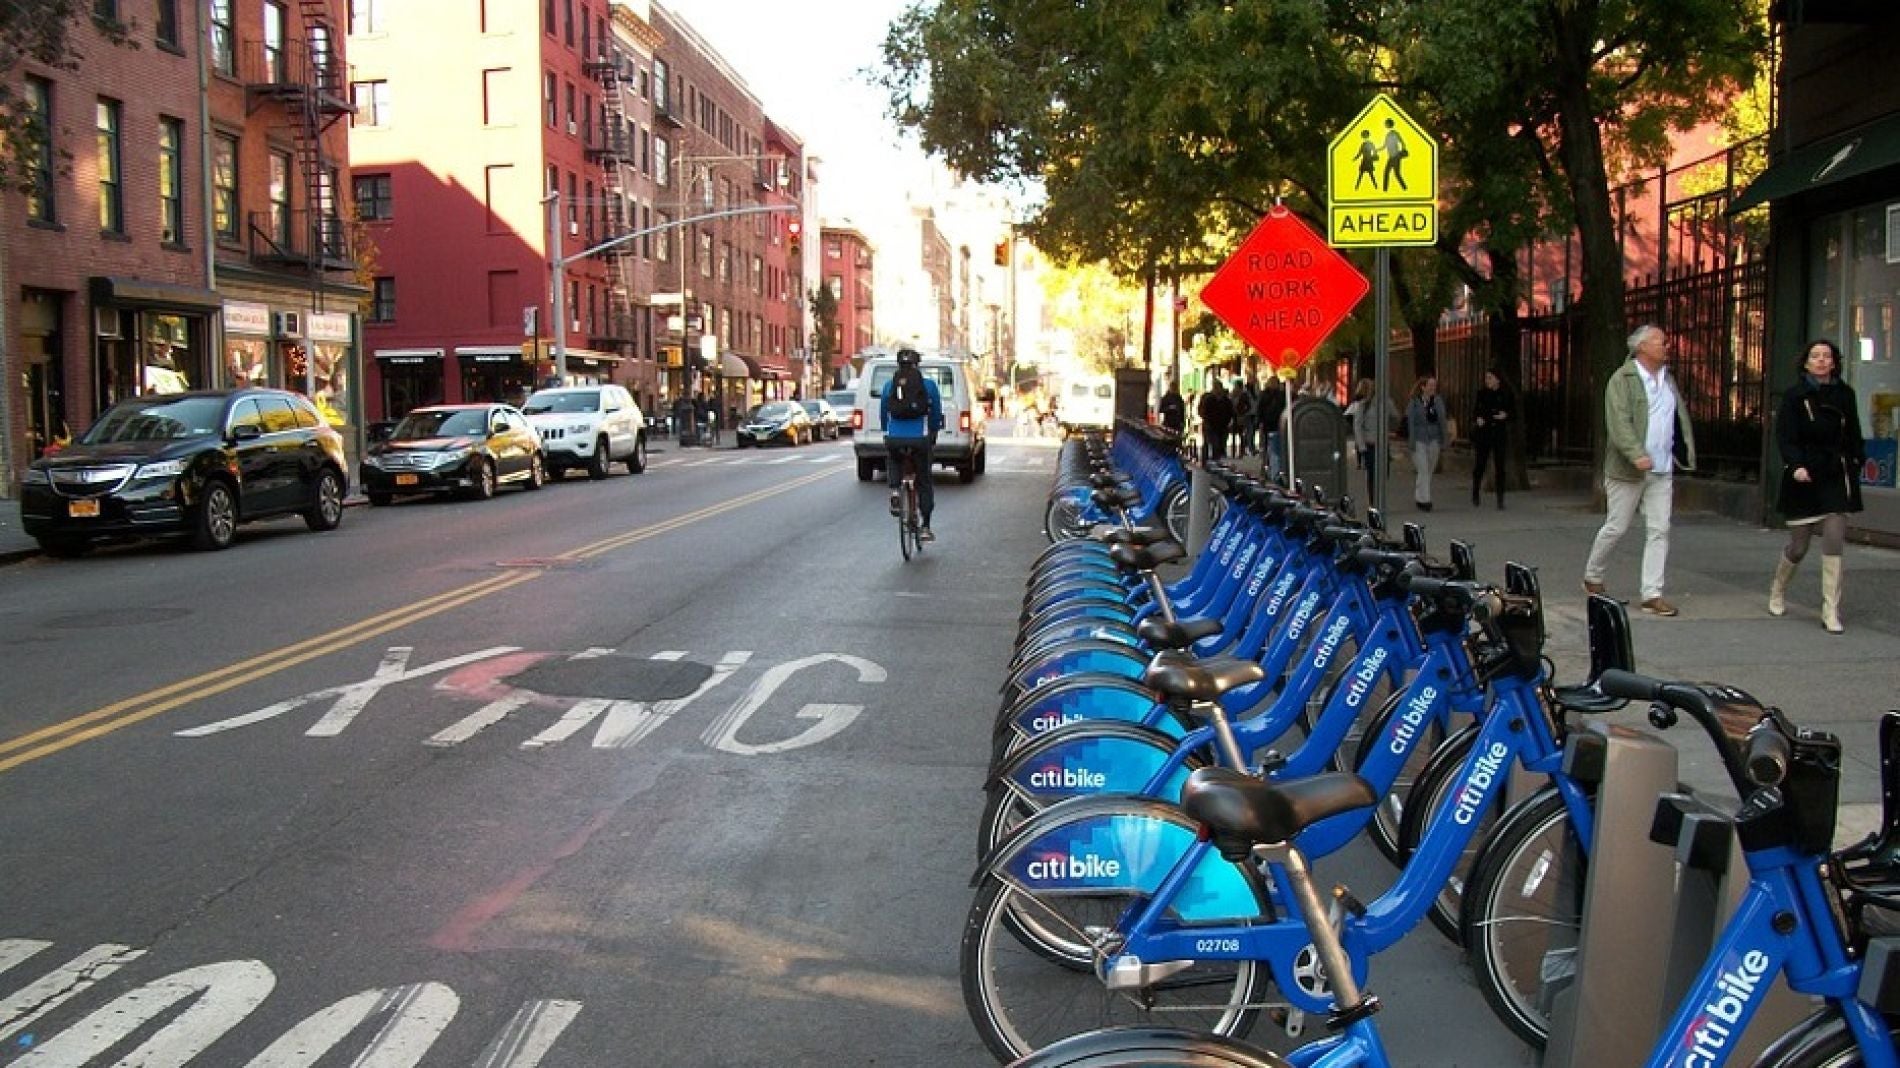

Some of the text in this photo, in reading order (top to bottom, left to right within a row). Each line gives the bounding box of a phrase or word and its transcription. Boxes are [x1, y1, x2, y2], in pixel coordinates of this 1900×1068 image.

[1340, 213, 1427, 233] AHEAD
[1248, 250, 1313, 272] ROAD
[1247, 279, 1318, 300] WORK
[1249, 308, 1321, 330] AHEAD
[1391, 687, 1437, 754] citi bike
[1031, 768, 1106, 788] citi bike
[1454, 742, 1508, 825] citi bike
[1027, 854, 1120, 880] citi bike
[1196, 939, 1240, 952] 02708
[1705, 949, 1769, 1024] bike
